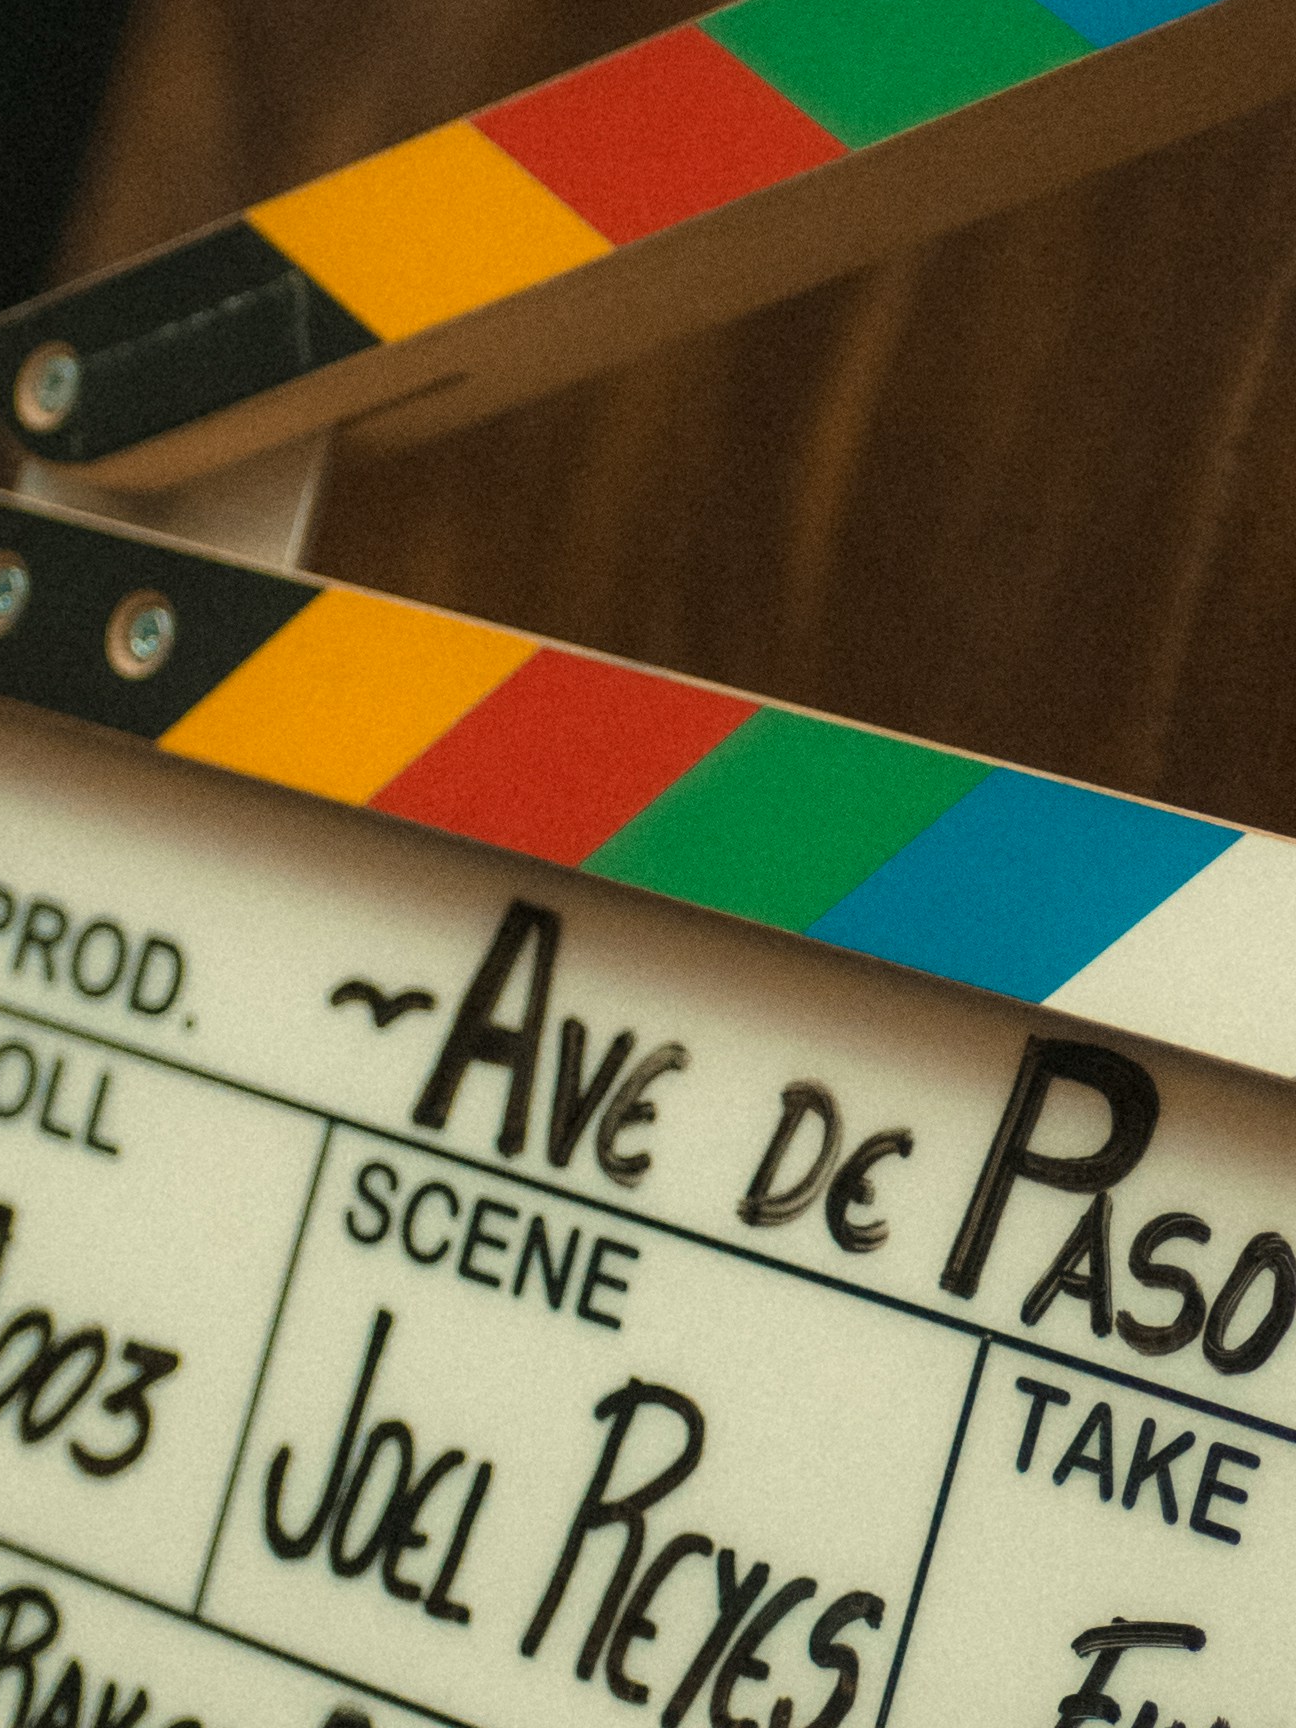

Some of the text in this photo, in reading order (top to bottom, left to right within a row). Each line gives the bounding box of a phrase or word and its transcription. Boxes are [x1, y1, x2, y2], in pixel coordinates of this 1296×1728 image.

[345, 1163, 641, 1330] SCENE
[264, 1309, 494, 1625] JOEL
[1015, 1376, 1261, 1546] TAKE
